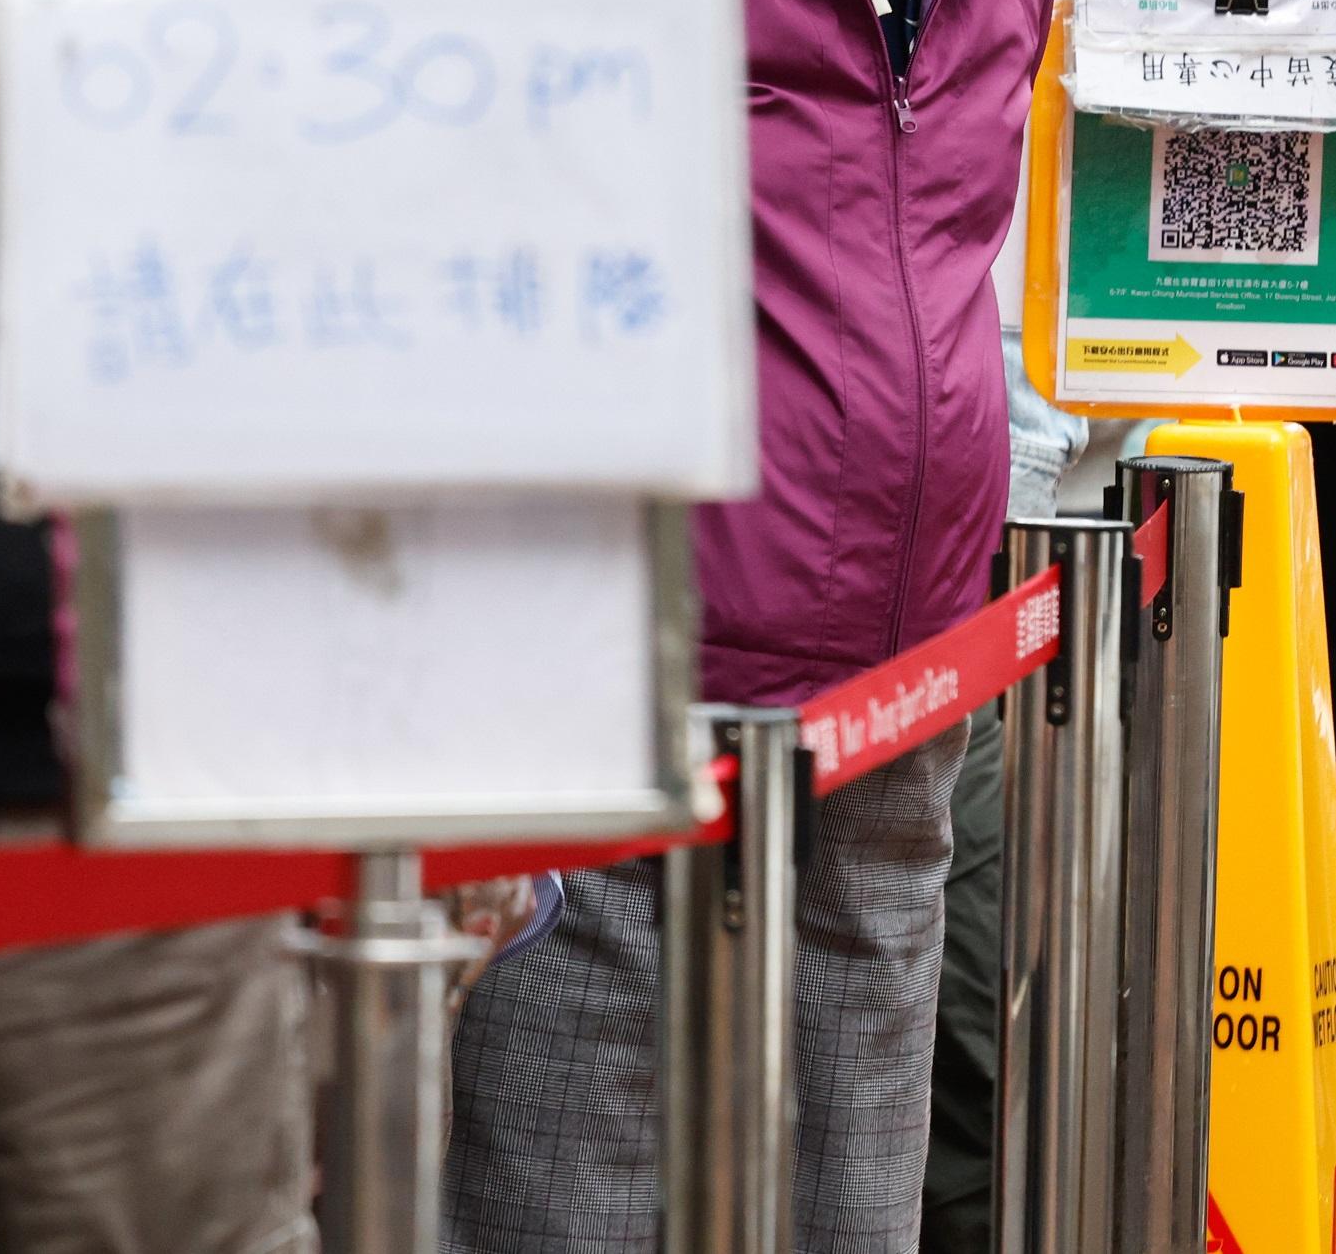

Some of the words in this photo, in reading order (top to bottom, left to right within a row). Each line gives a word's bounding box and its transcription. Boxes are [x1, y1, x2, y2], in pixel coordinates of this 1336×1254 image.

[523, 39, 654, 138] pm
[1231, 357, 1244, 365] App
[1246, 357, 1264, 365] Store
[1287, 358, 1309, 367] Google
[1310, 358, 1325, 368] Play
[1213, 1012, 1281, 1052] OOR
